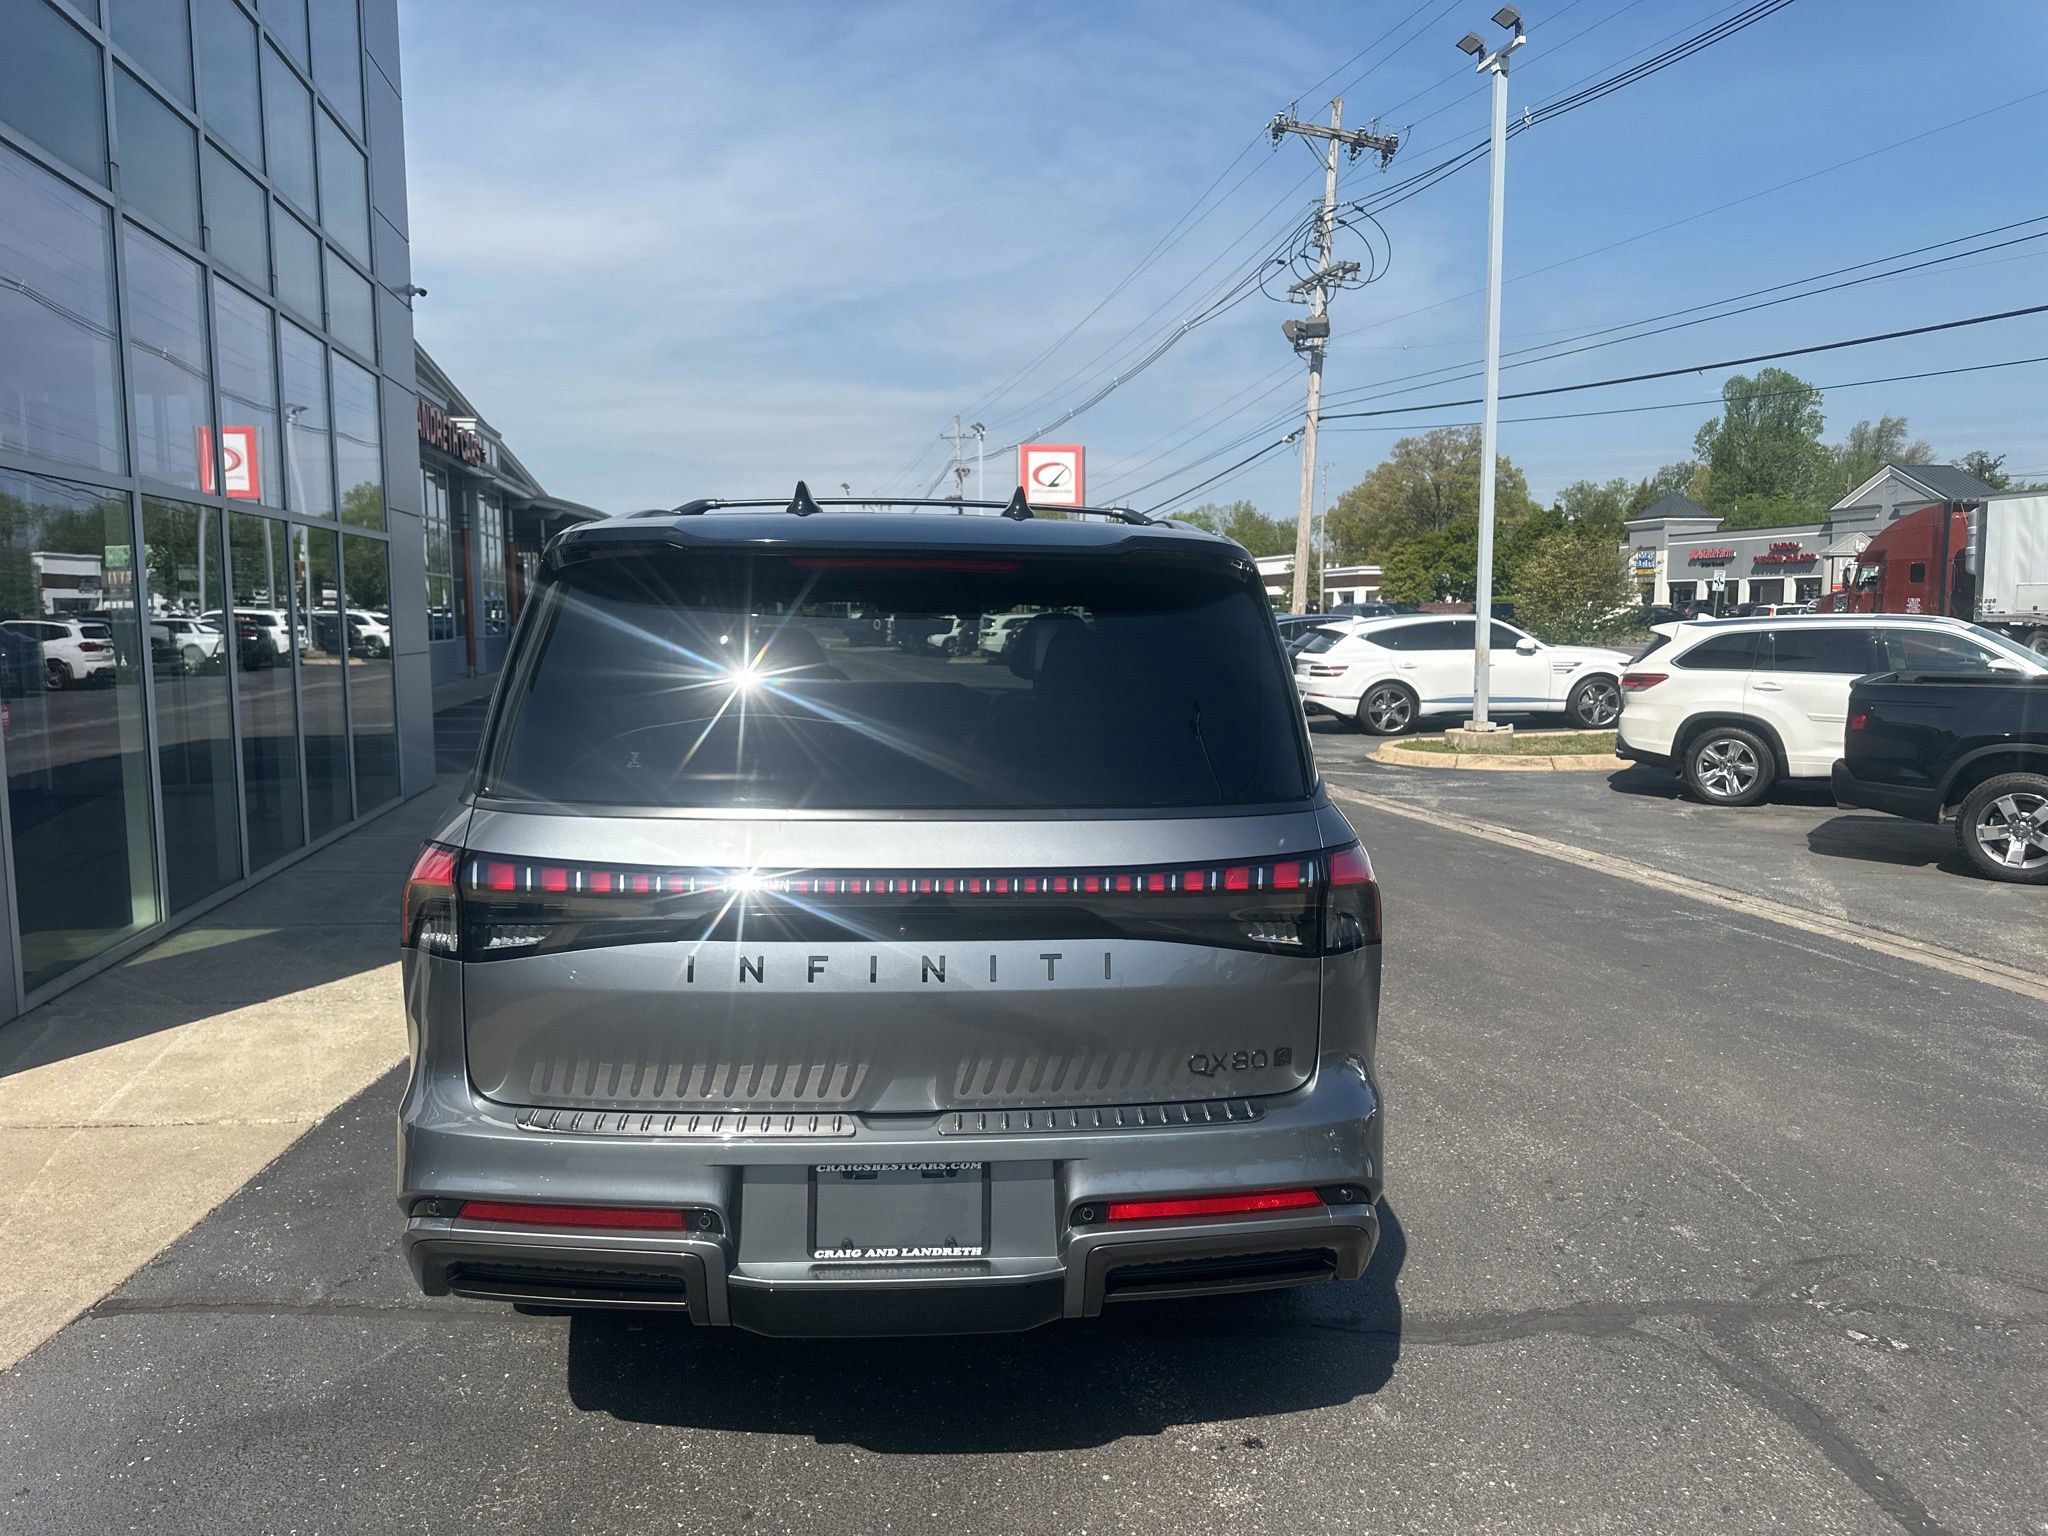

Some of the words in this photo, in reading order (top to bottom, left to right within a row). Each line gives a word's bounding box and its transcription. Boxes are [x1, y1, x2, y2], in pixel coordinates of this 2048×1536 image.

[687, 953, 1112, 983] INFINITI
[1188, 1050, 1268, 1077] QX80
[814, 1249, 862, 1259] CRAIG
[865, 1248, 898, 1257] AND
[901, 1247, 982, 1256] LANDRETH
